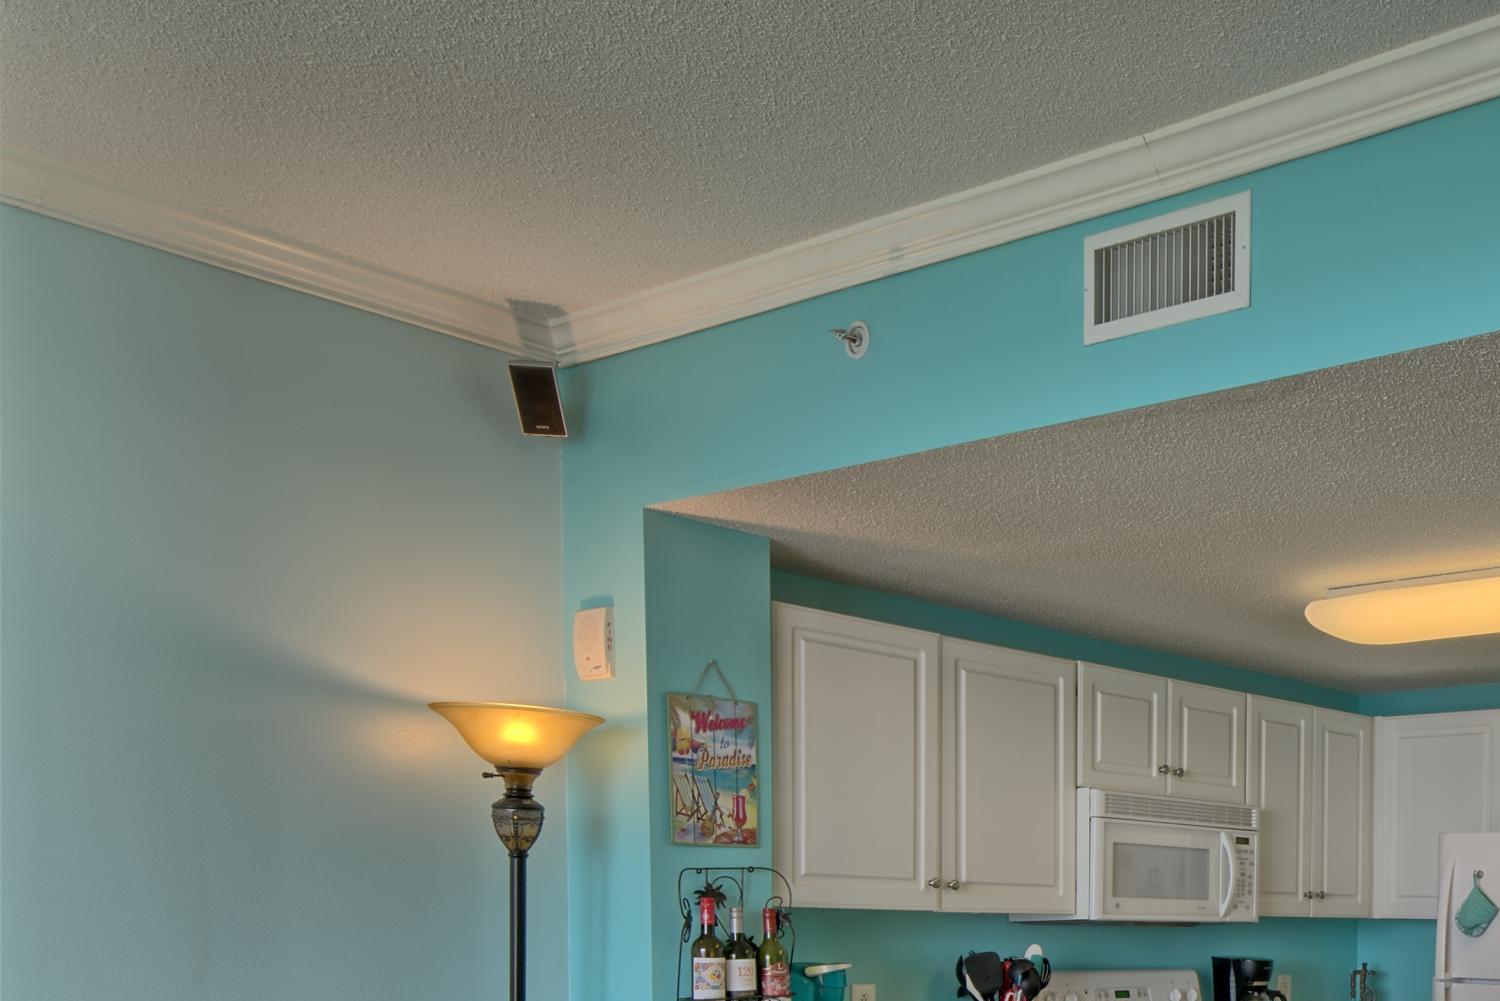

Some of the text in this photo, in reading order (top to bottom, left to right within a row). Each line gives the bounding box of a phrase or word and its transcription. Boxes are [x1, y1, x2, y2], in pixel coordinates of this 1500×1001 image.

[689, 710, 746, 733] Welcome
[720, 736, 730, 750] to
[696, 746, 753, 771] Paradise
